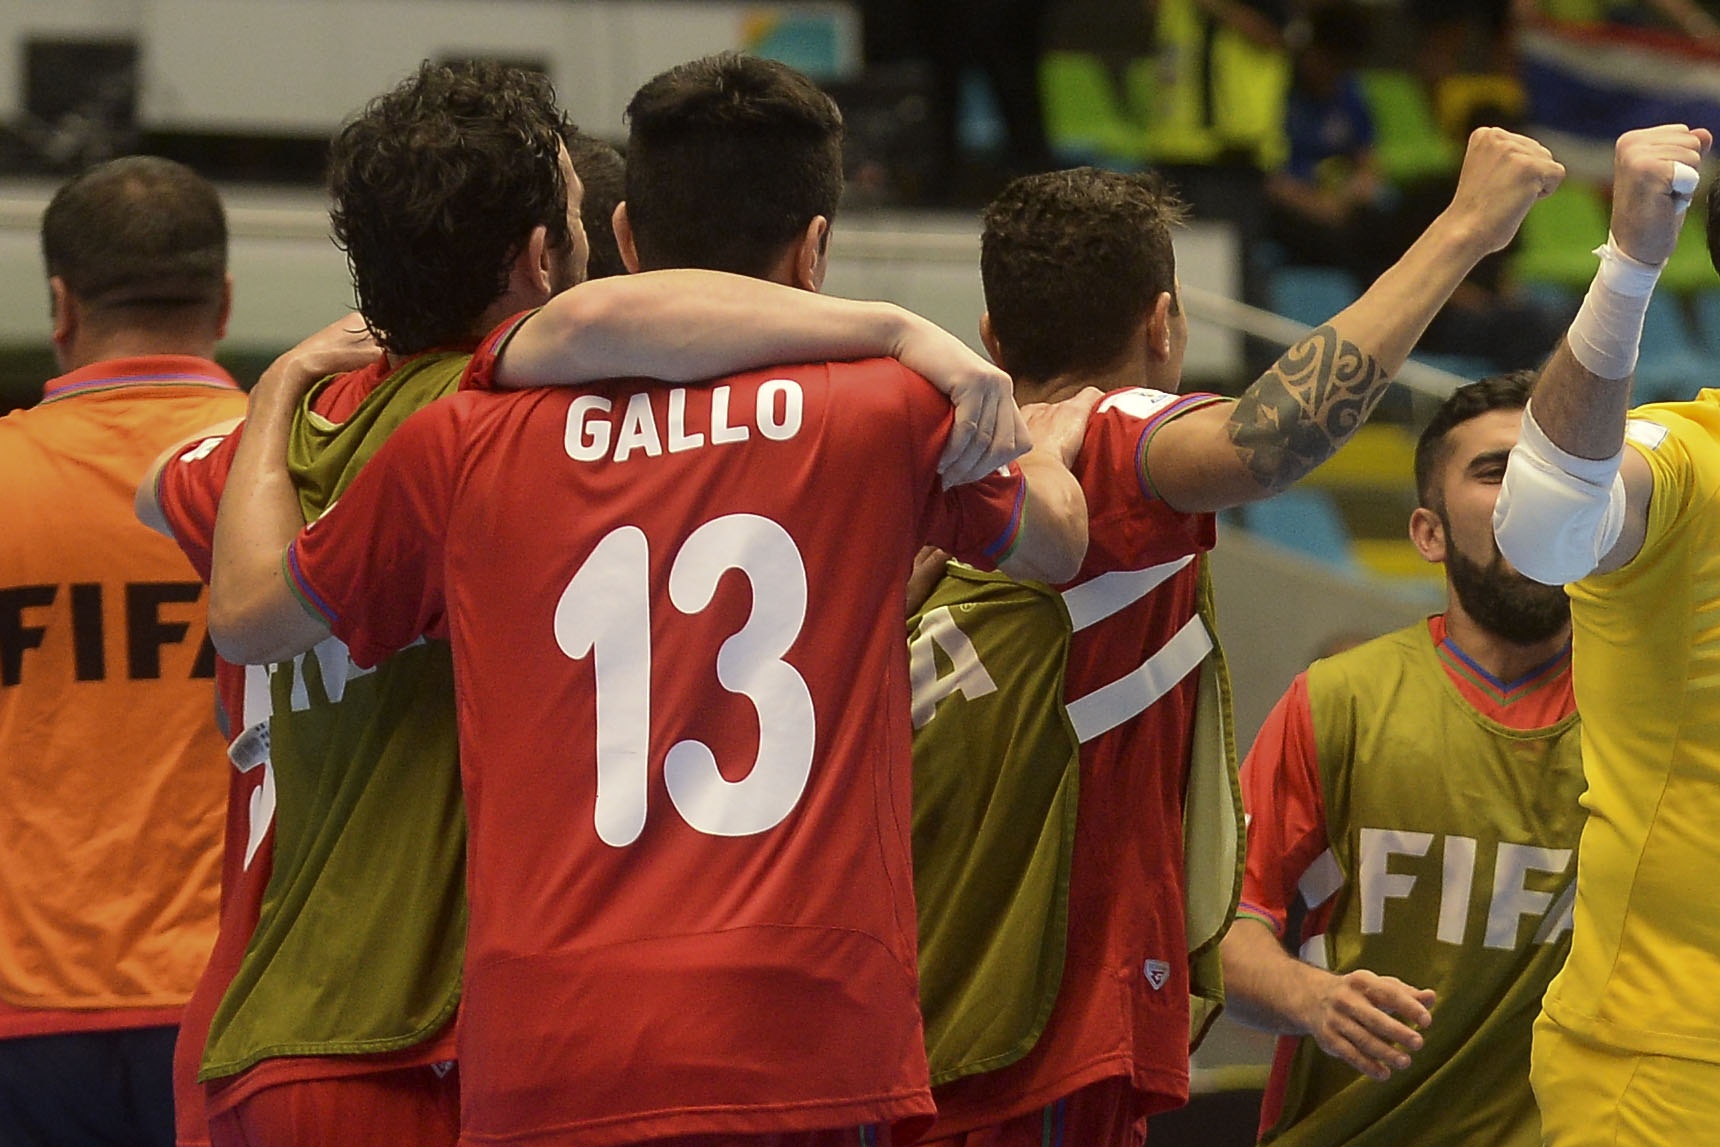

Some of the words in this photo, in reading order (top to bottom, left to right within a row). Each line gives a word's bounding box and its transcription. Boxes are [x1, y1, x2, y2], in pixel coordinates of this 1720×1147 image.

[564, 379, 804, 463] GALLO
[0, 581, 217, 687] FIF
[554, 513, 815, 847] 13
[1359, 827, 1578, 950] FIF
